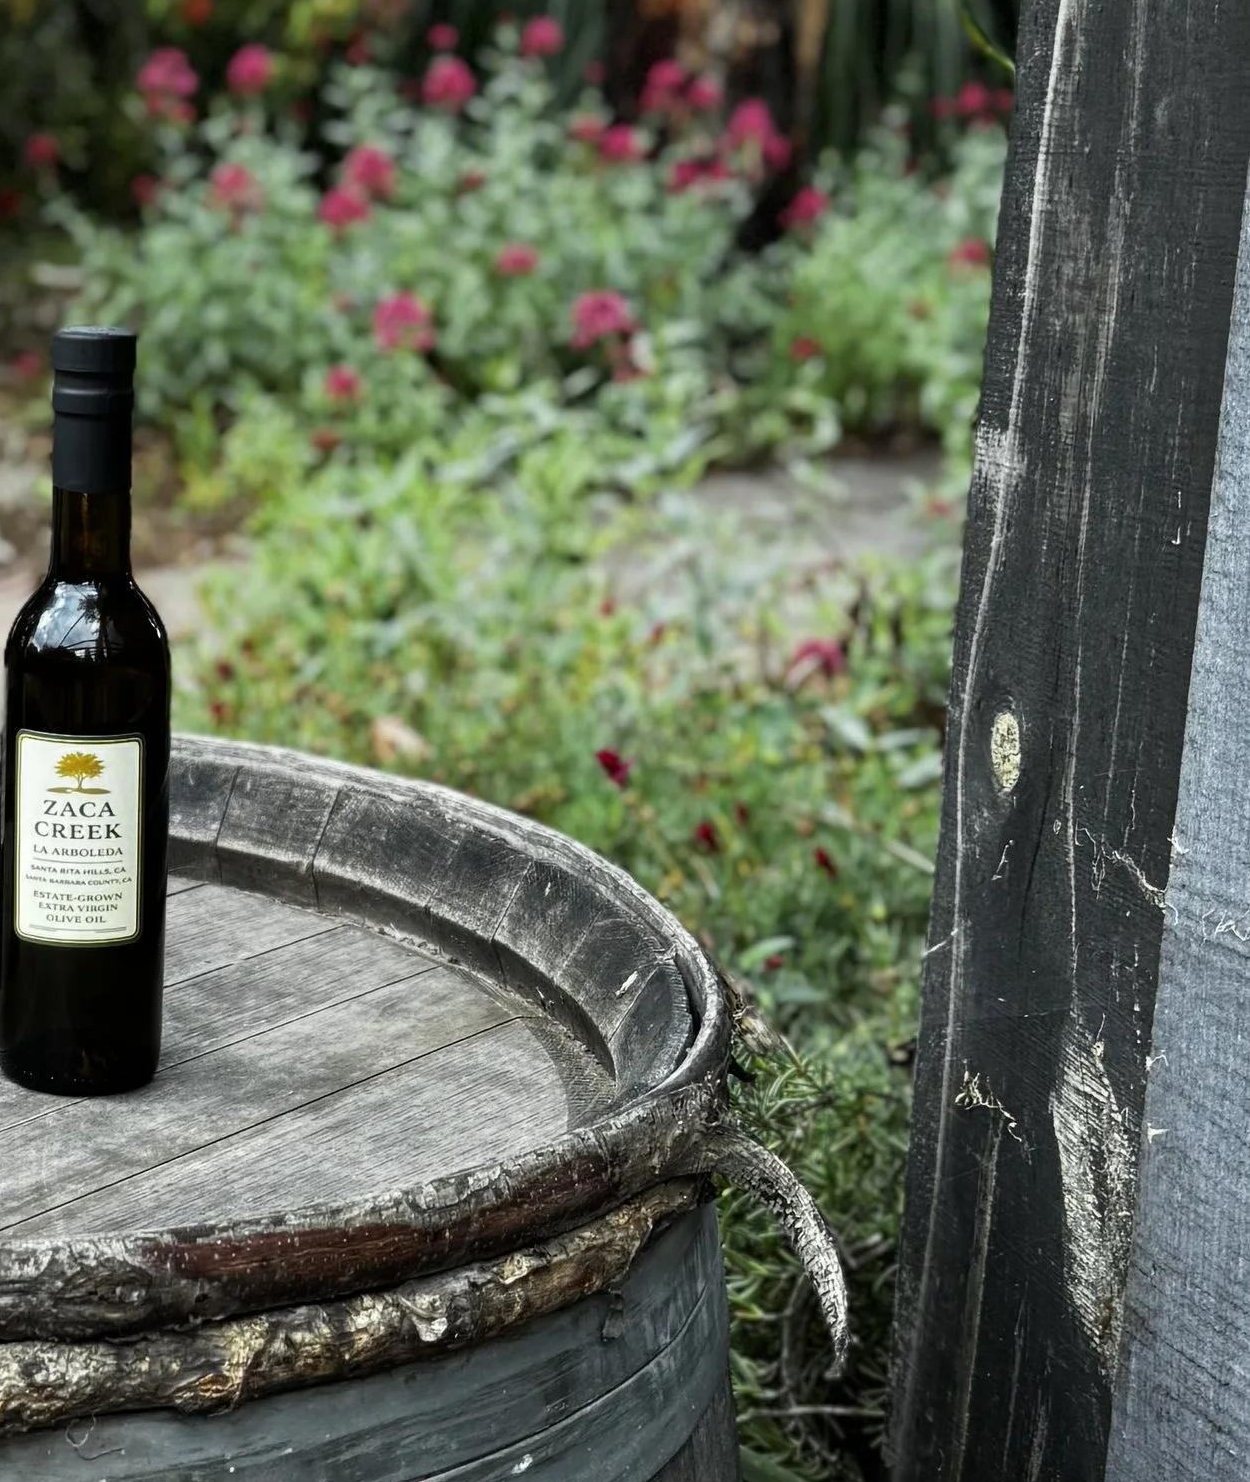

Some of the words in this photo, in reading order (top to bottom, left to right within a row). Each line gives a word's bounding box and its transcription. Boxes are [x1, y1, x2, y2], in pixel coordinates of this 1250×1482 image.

[44, 799, 116, 817] ZACA
[34, 821, 122, 839] CREEK
[34, 844, 48, 854] LA
[52, 847, 123, 857] ARBOLEDA
[31, 864, 57, 874] SANTA
[26, 874, 46, 882] SANTA
[34, 890, 123, 901] ESTATE-GROWN
[39, 902, 74, 912] EXTRA
[78, 904, 118, 912] VIRGIN
[46, 914, 82, 923] OLIVE
